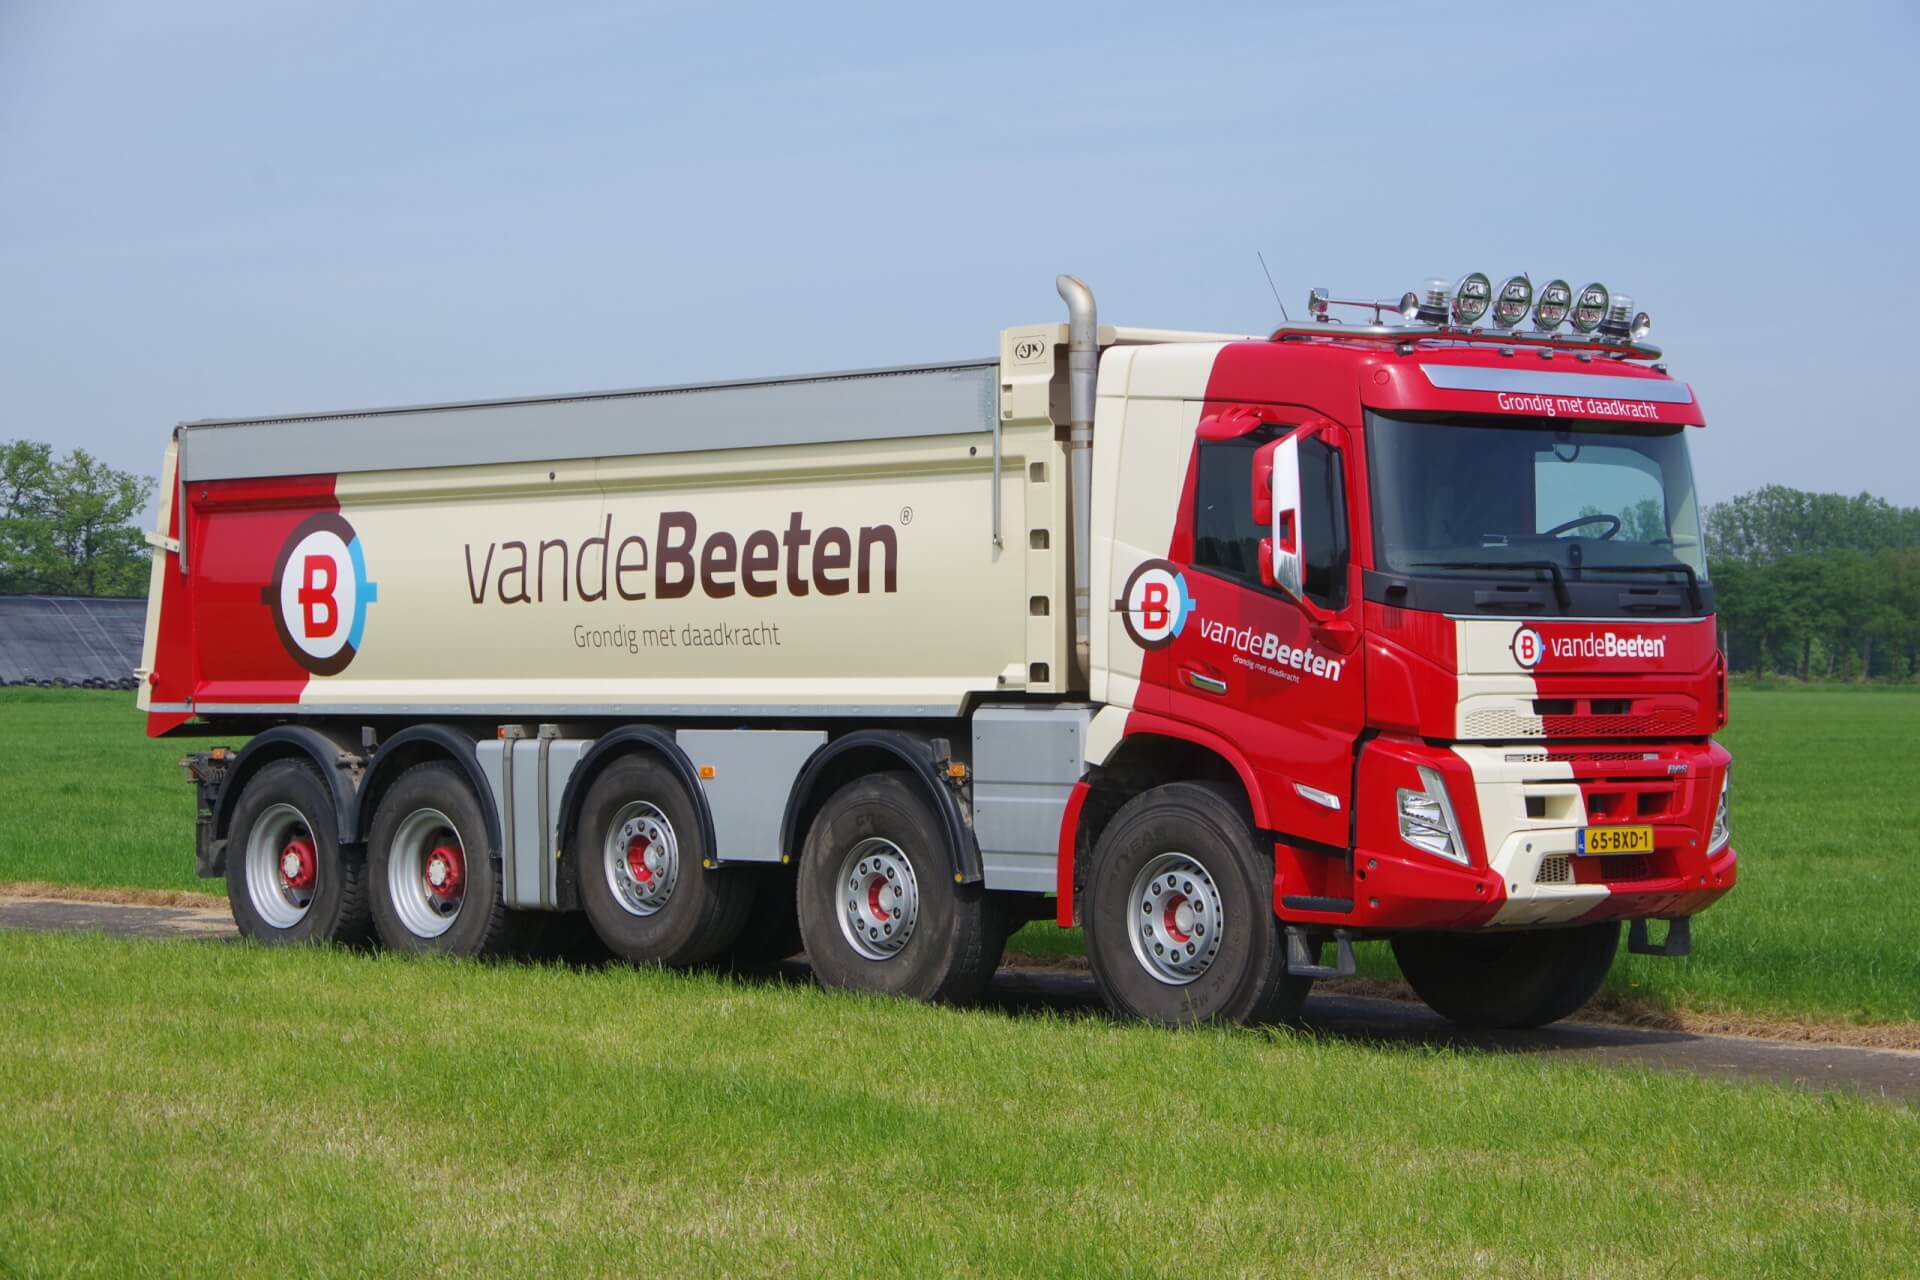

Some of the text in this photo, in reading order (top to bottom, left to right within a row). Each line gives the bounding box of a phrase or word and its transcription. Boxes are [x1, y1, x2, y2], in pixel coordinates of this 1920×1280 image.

[1497, 393, 1660, 420] Grondig met daadkracht
[573, 620, 782, 655] Grondig met daadkracht
[1232, 653, 1301, 684] Grondig met daadkracht
[1590, 830, 1649, 849] 65-BXD-1
